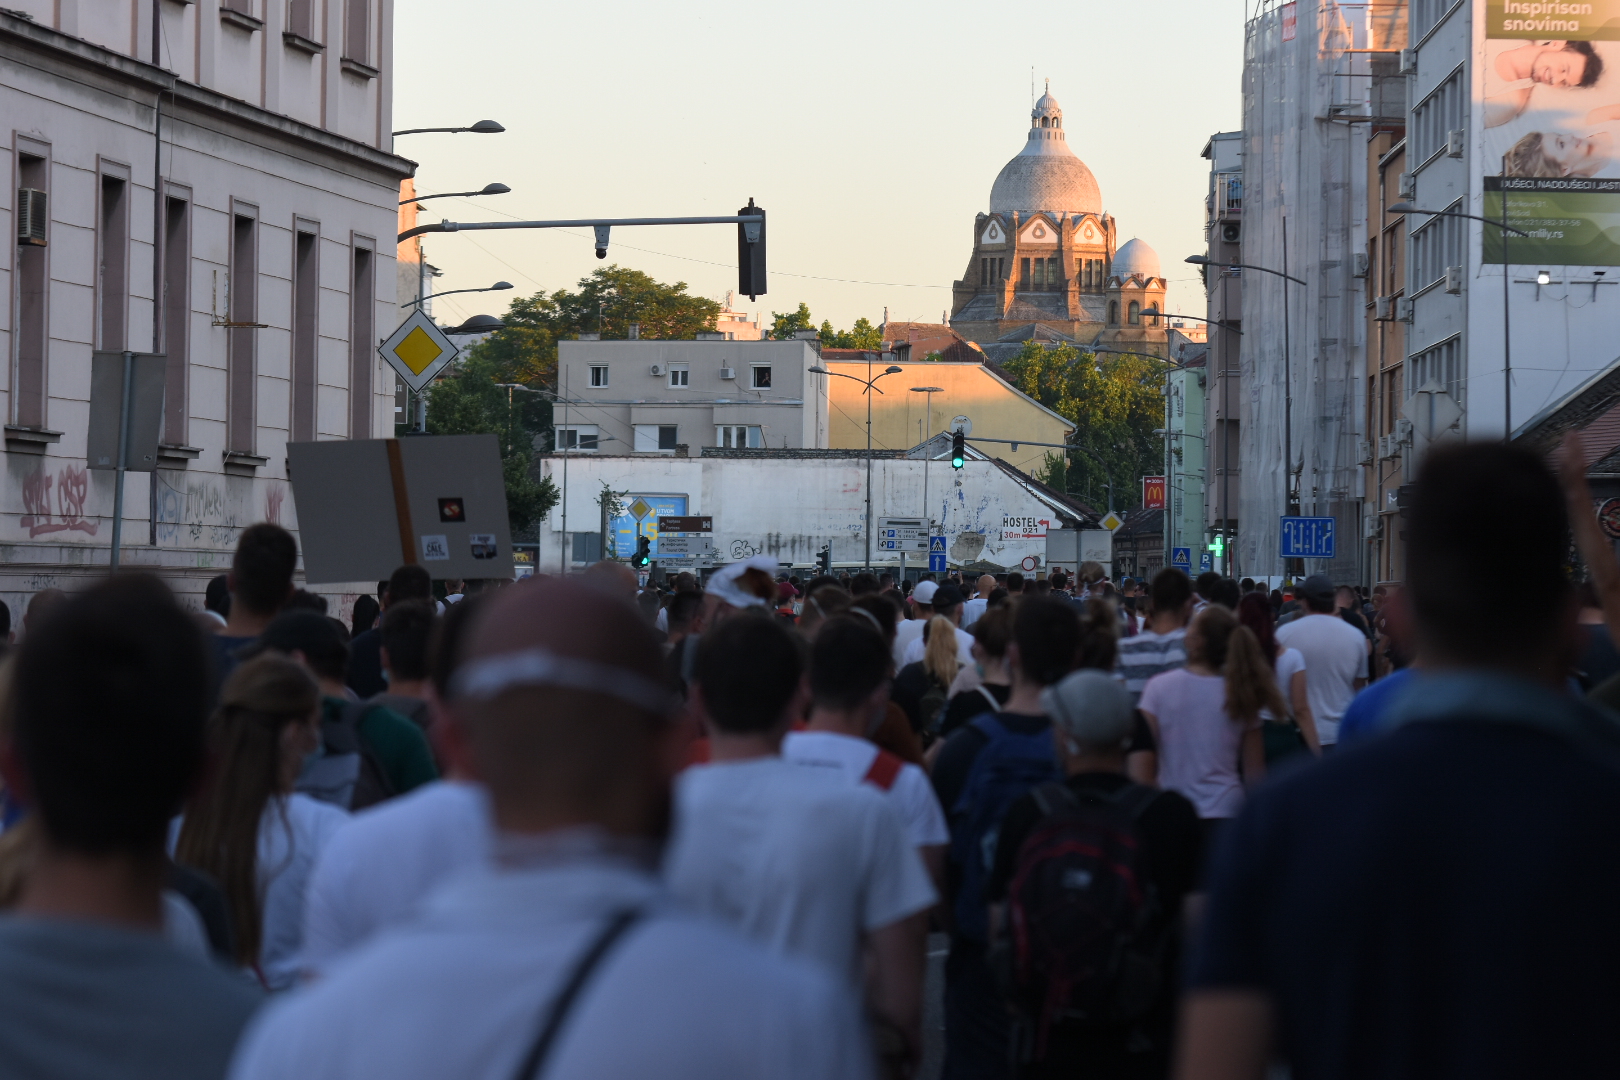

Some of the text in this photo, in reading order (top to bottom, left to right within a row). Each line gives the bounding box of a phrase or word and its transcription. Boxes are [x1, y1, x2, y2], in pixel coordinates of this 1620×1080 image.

[1504, 0, 1592, 17] Inspirisan
[1503, 16, 1579, 31] snovima
[1537, 179, 1591, 189] NADDUŠECI
[1003, 517, 1038, 527] HOSTEL
